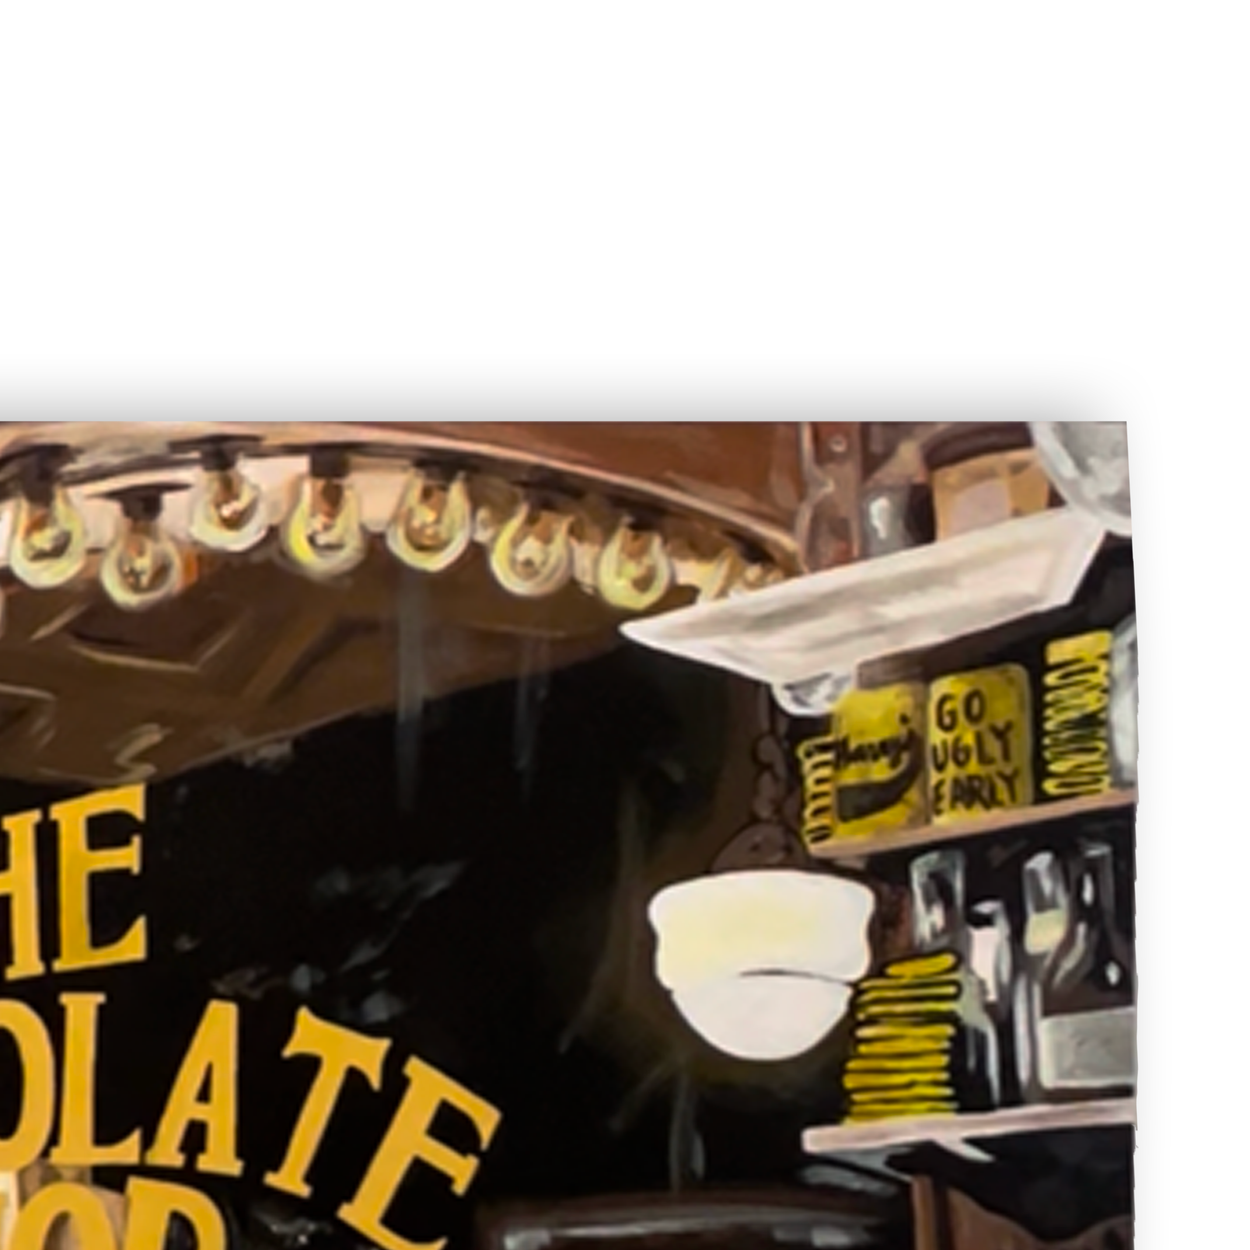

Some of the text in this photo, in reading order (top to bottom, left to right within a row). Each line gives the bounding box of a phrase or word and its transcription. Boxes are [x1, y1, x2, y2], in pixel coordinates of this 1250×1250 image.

[936, 688, 987, 733] GO
[932, 721, 1014, 774] UGLY
[933, 766, 1019, 816] EARLY
